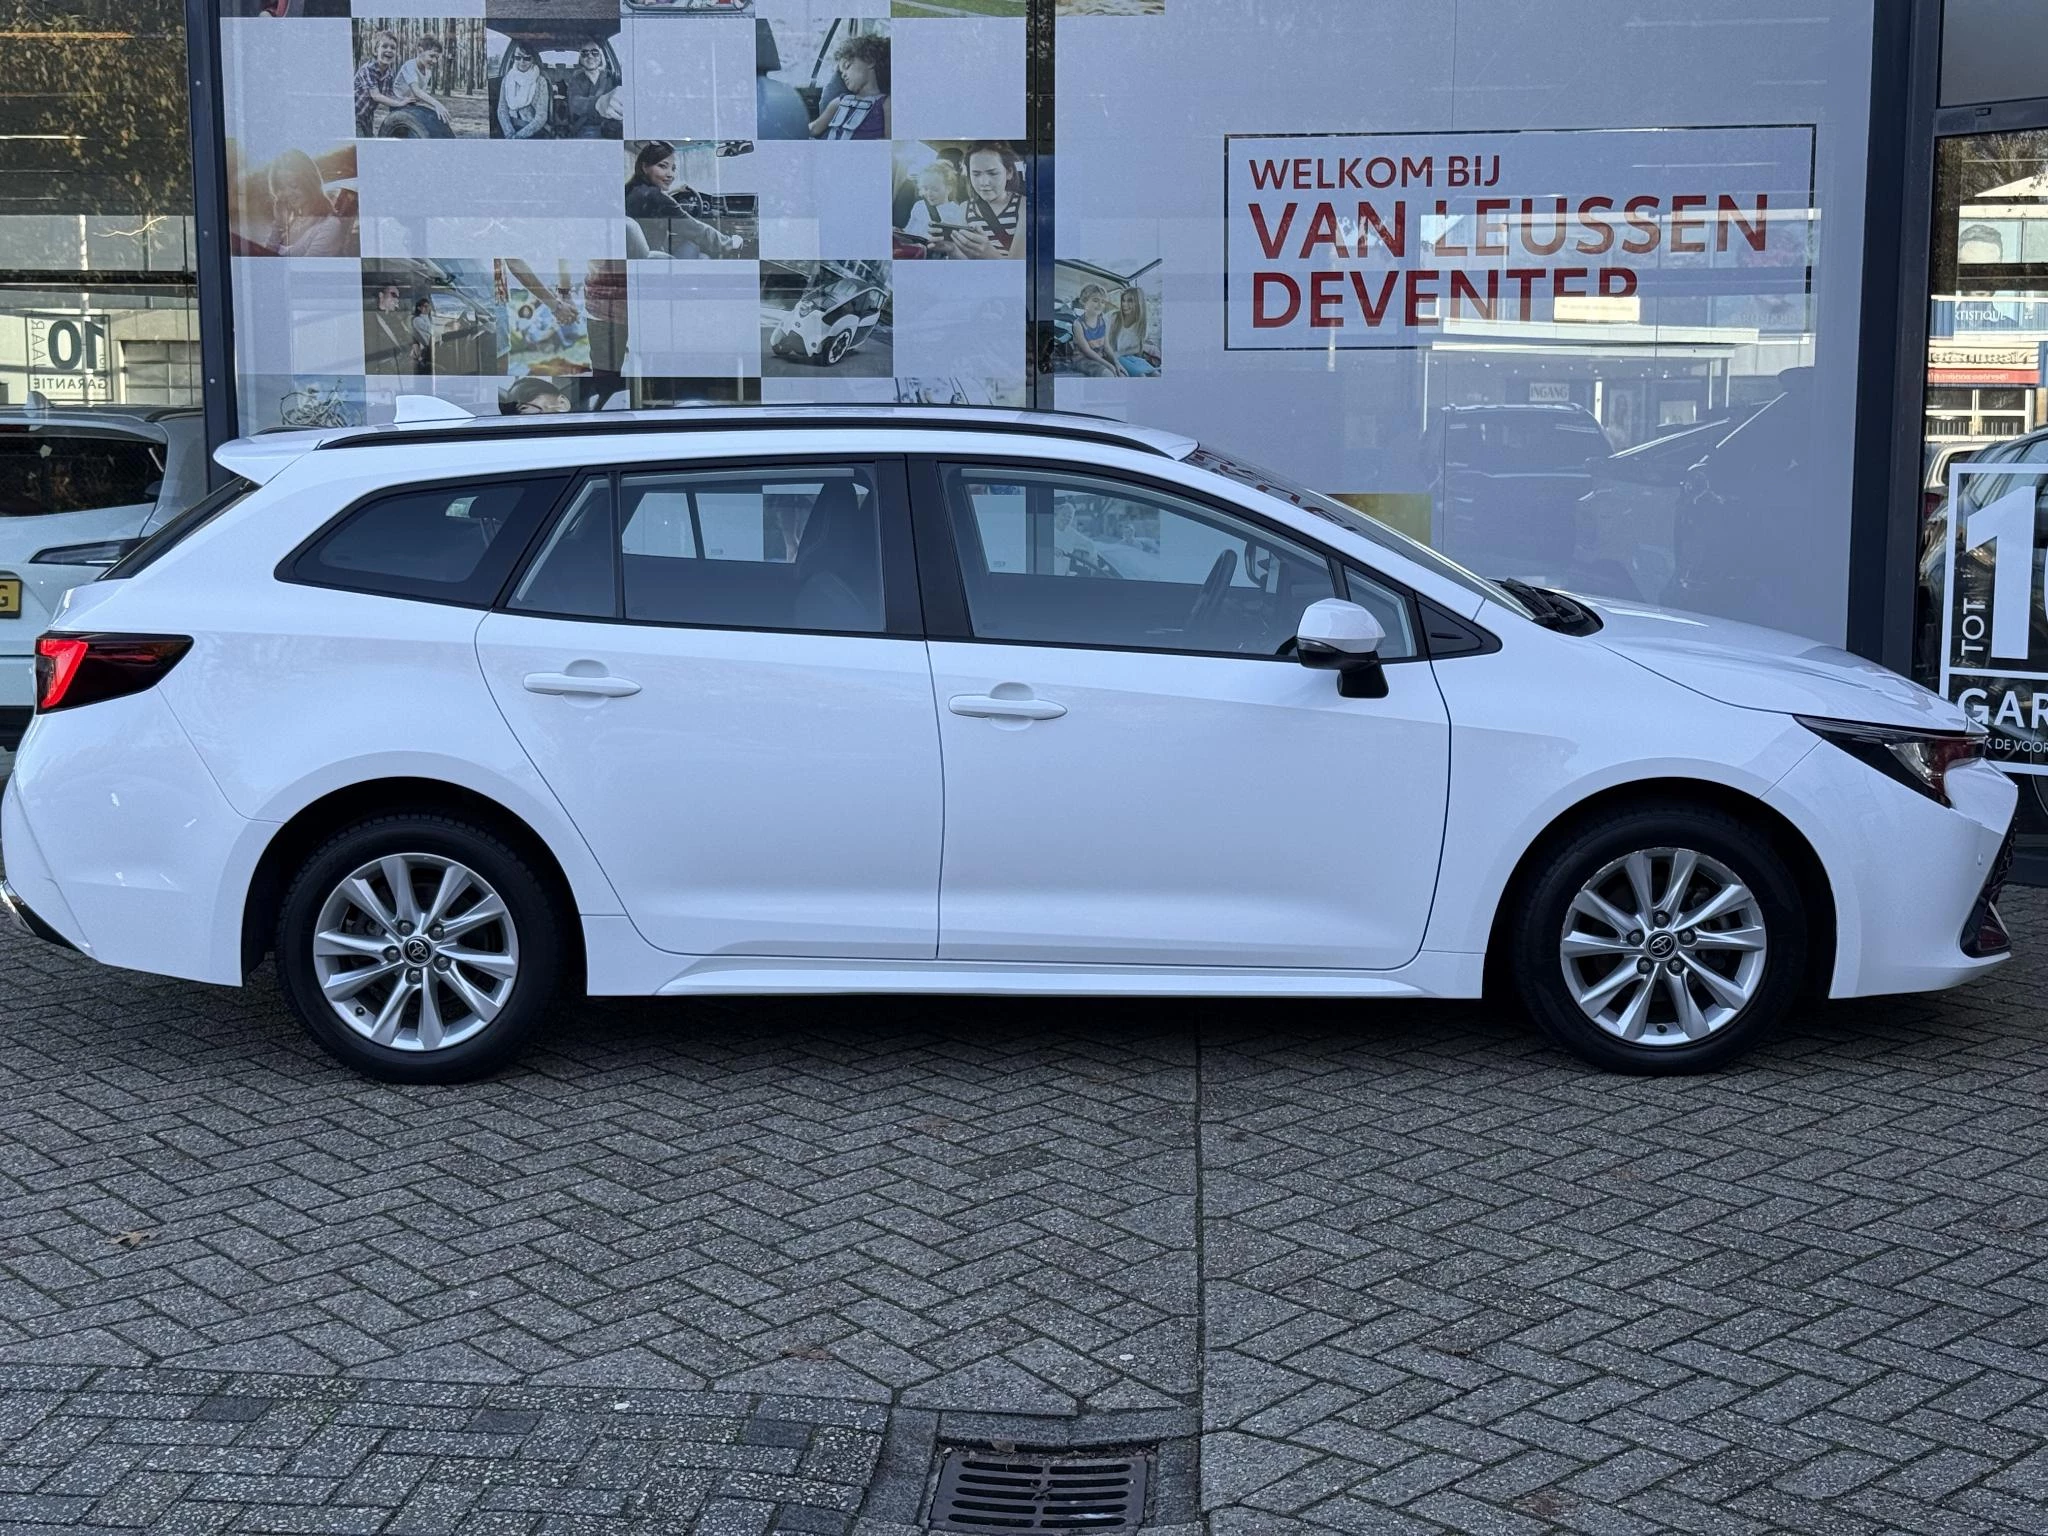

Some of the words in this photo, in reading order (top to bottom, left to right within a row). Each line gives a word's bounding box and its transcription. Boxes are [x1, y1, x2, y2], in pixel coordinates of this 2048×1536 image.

[1249, 156, 1433, 190] WELKOM
[1448, 155, 1500, 187] BIJ
[1248, 201, 1406, 259] VAN
[1434, 194, 1768, 257] LEUSSEN
[1961, 598, 1985, 656] TOT
[1995, 739, 2011, 751] DE
